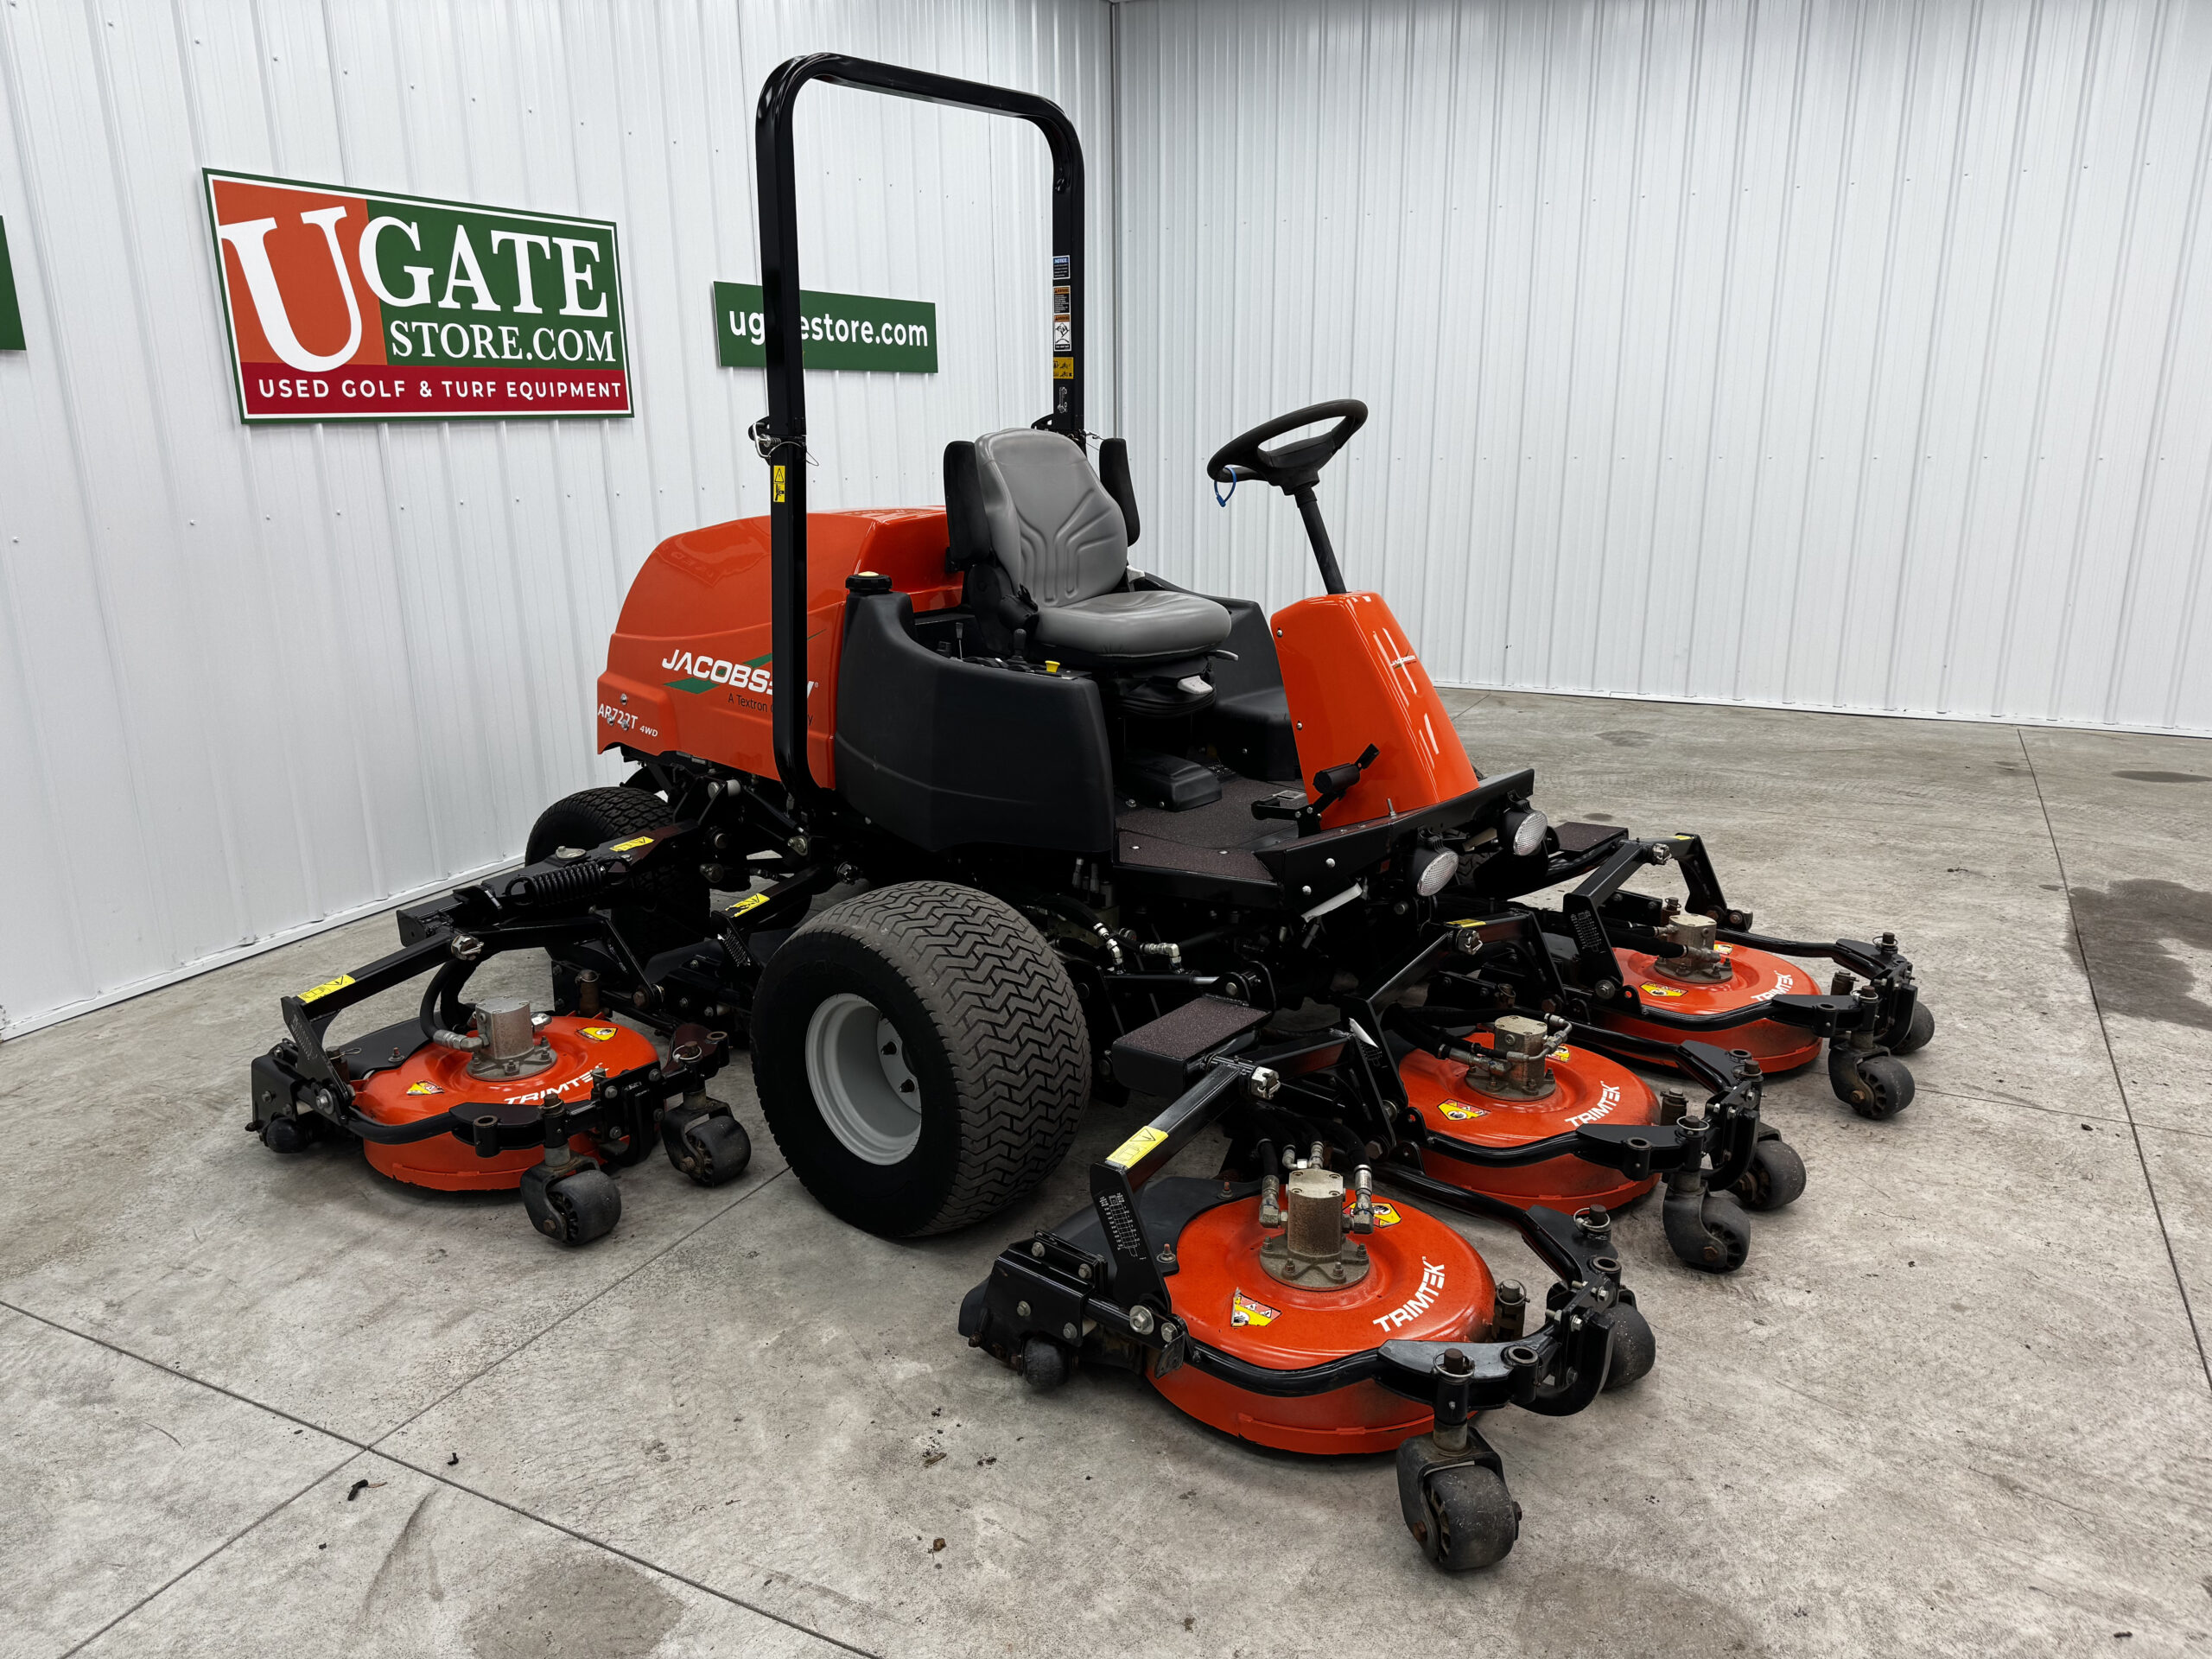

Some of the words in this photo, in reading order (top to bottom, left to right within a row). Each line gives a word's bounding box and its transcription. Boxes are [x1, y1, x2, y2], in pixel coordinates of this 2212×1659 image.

[390, 321, 617, 362] STORE.COM
[728, 309, 928, 347] ugestore.com
[259, 378, 329, 399] USED
[341, 379, 406, 399] GOLF
[419, 380, 433, 398] &
[442, 381, 497, 399] TURF
[506, 381, 622, 401] EQUIPMENT
[662, 649, 815, 698] JACOBS
[728, 693, 734, 703] A
[736, 694, 768, 713] Textron
[639, 725, 658, 737] 4WD
[504, 1064, 608, 1105] TRIMTE
[1564, 1083, 1621, 1128] TRIMTEK
[1372, 1259, 1446, 1332] TRIMTEK
